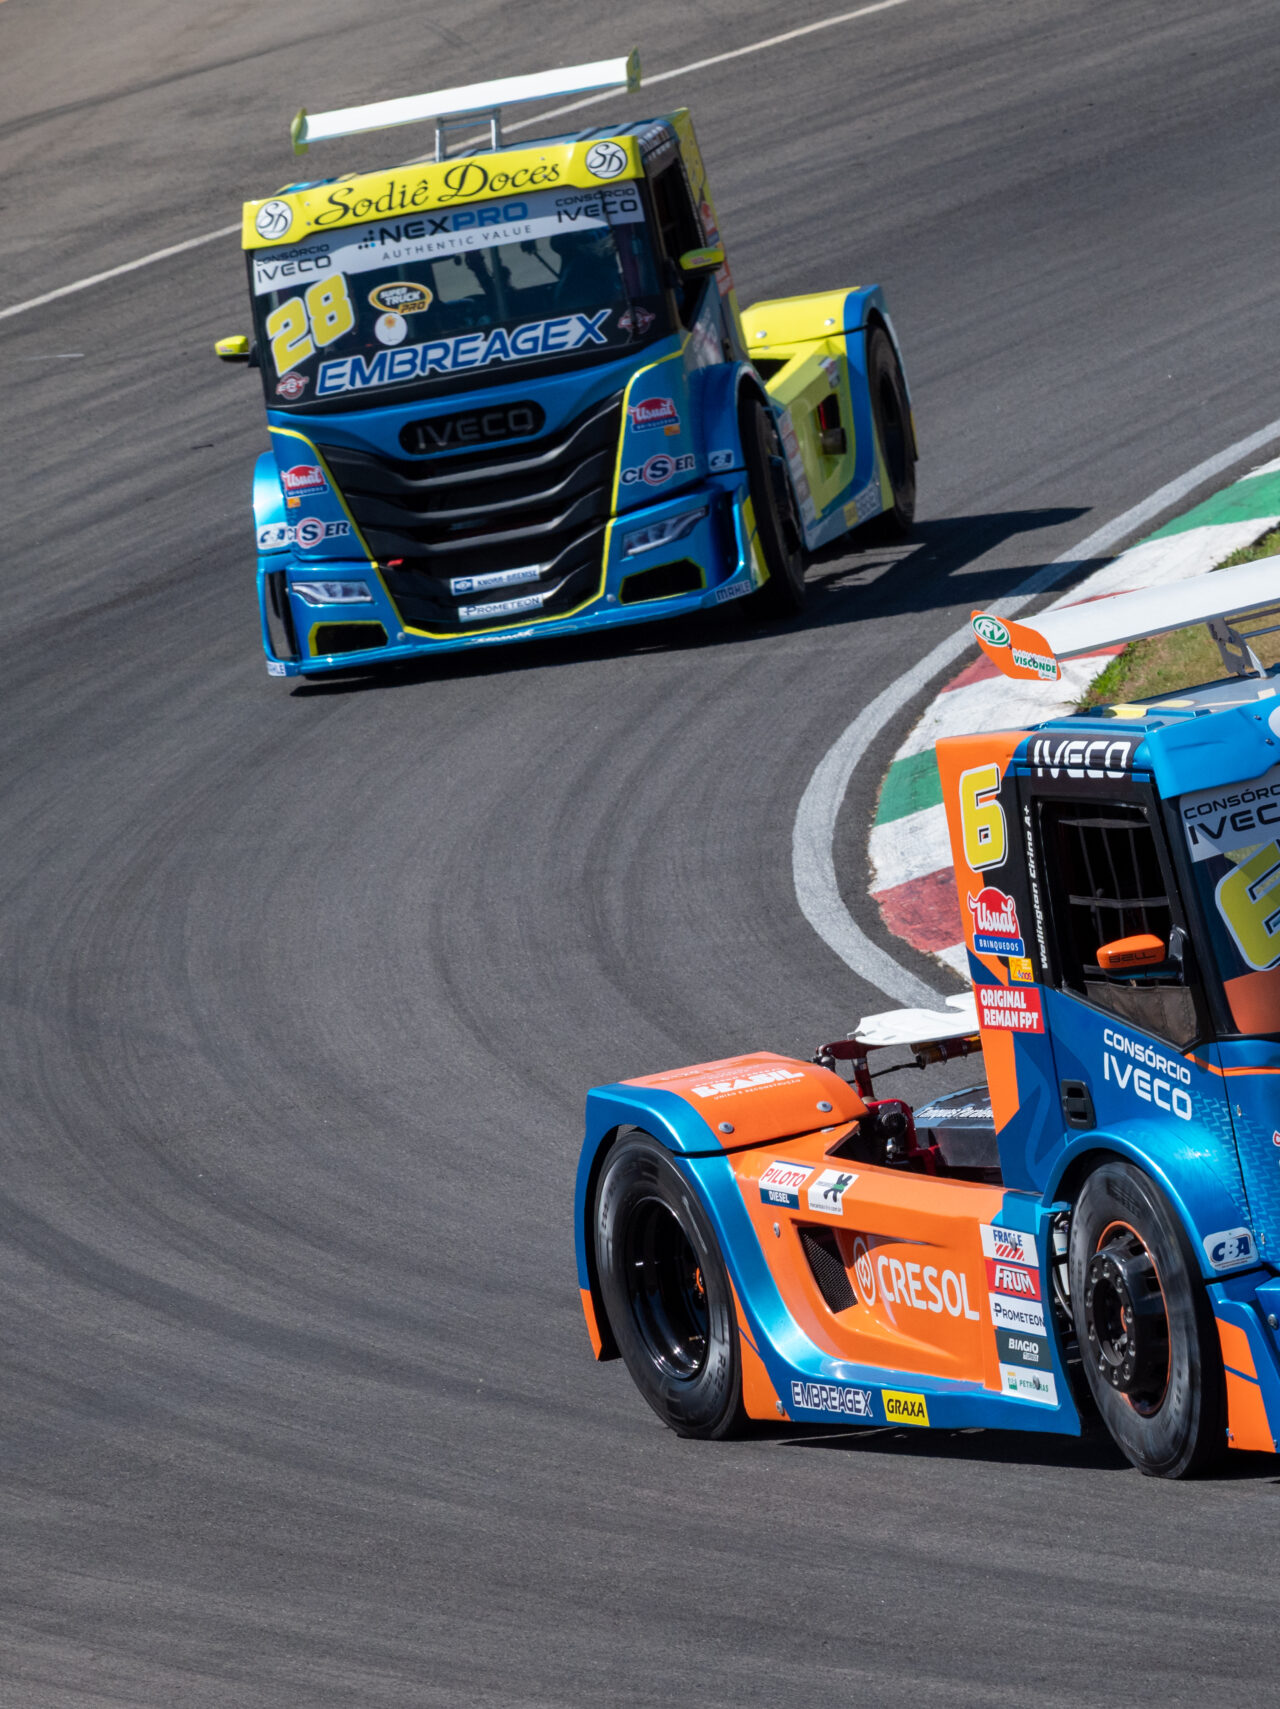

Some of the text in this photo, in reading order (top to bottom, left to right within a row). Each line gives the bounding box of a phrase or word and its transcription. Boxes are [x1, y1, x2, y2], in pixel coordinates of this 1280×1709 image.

[314, 161, 560, 226] Sodiê Doces
[380, 202, 529, 246] NEXPRO
[556, 199, 638, 224] IVECO
[382, 225, 532, 261] AUTHENTIC VALUE
[257, 255, 332, 284] IVECO
[385, 291, 421, 306] TRUCK
[400, 300, 426, 314] PRO
[266, 272, 355, 378] 28
[315, 308, 612, 396] EMBREAGEX
[416, 408, 533, 449] IVECO
[621, 454, 695, 484] CISER
[464, 597, 540, 616] PROMETEON
[978, 620, 1005, 641] RV
[1013, 655, 1057, 674] VISCONDE
[1033, 739, 1132, 779] IVECO
[958, 762, 1008, 873] 6
[1023, 804, 1048, 969] Wellington Cirino A+
[969, 899, 1016, 934] Usual
[978, 937, 1019, 952] BRINQUEDOS
[980, 988, 1026, 1010] ORIGINAL
[984, 1008, 1039, 1030] REMAN FPT
[1103, 1028, 1191, 1085] CONSÓRCIO
[691, 1069, 805, 1098] BRASIL
[1103, 1052, 1192, 1121] IVECO
[760, 1168, 807, 1188] PILOTO
[768, 1190, 790, 1204] DIESEL
[1212, 1236, 1250, 1262] CBA
[877, 1255, 980, 1321] CRESOL
[994, 1264, 1036, 1296] FRUM
[993, 1302, 1045, 1326] PROMETEON
[1008, 1338, 1039, 1354] BIAGIO
[791, 1380, 873, 1417] EMBREAGEX
[886, 1398, 925, 1418] GRAXA
